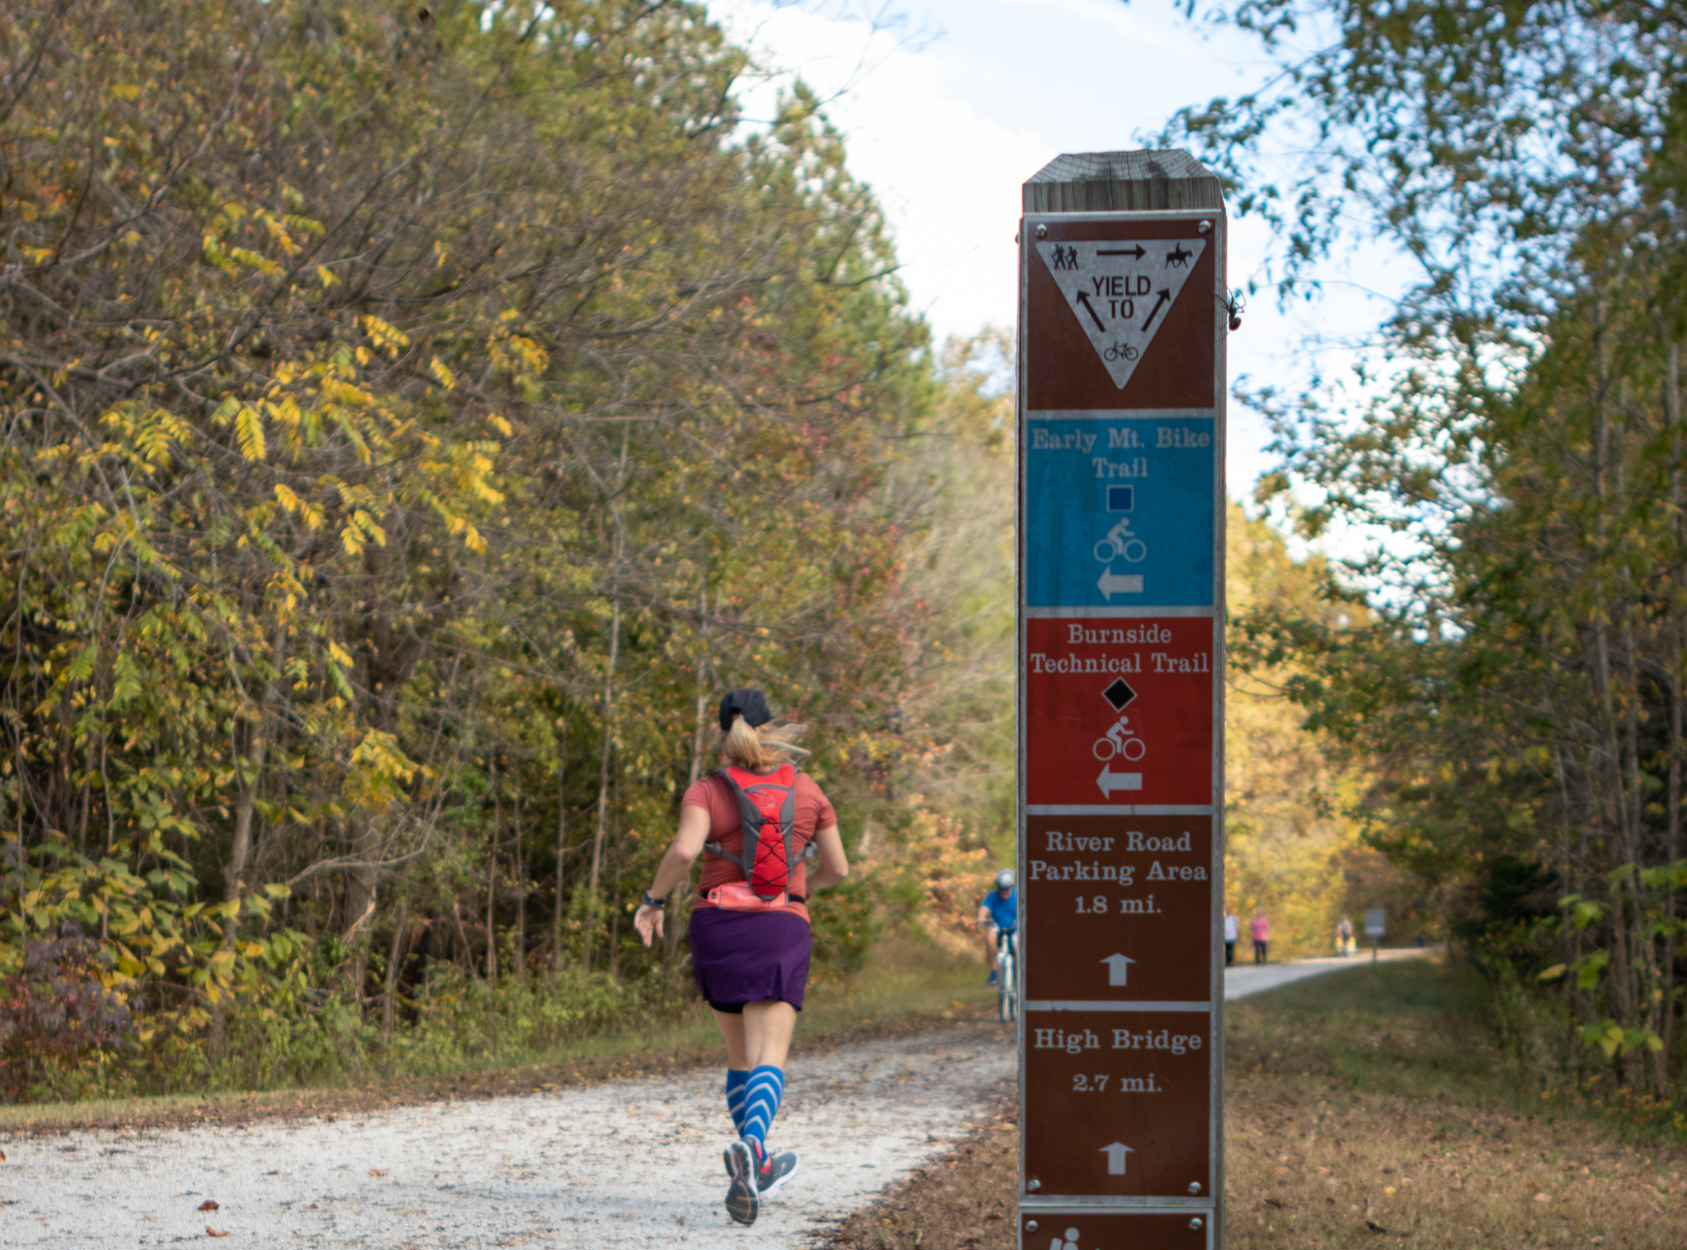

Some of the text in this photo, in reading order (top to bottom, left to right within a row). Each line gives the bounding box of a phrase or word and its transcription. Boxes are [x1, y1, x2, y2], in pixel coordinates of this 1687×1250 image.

[1091, 275, 1151, 297] YIELD
[1108, 299, 1134, 319] TO
[1032, 427, 1210, 454] Early Mt. Bike
[1092, 457, 1148, 478] Trail
[1067, 623, 1172, 644] Burnside
[1030, 652, 1209, 673] Technical Trail
[1045, 831, 1192, 851] River Road
[1029, 860, 1208, 886] Parking Area
[1075, 894, 1162, 914] 1.8 mi.
[1034, 1028, 1202, 1055] High Bridge
[1072, 1073, 1163, 1092] 2.7 mi.
